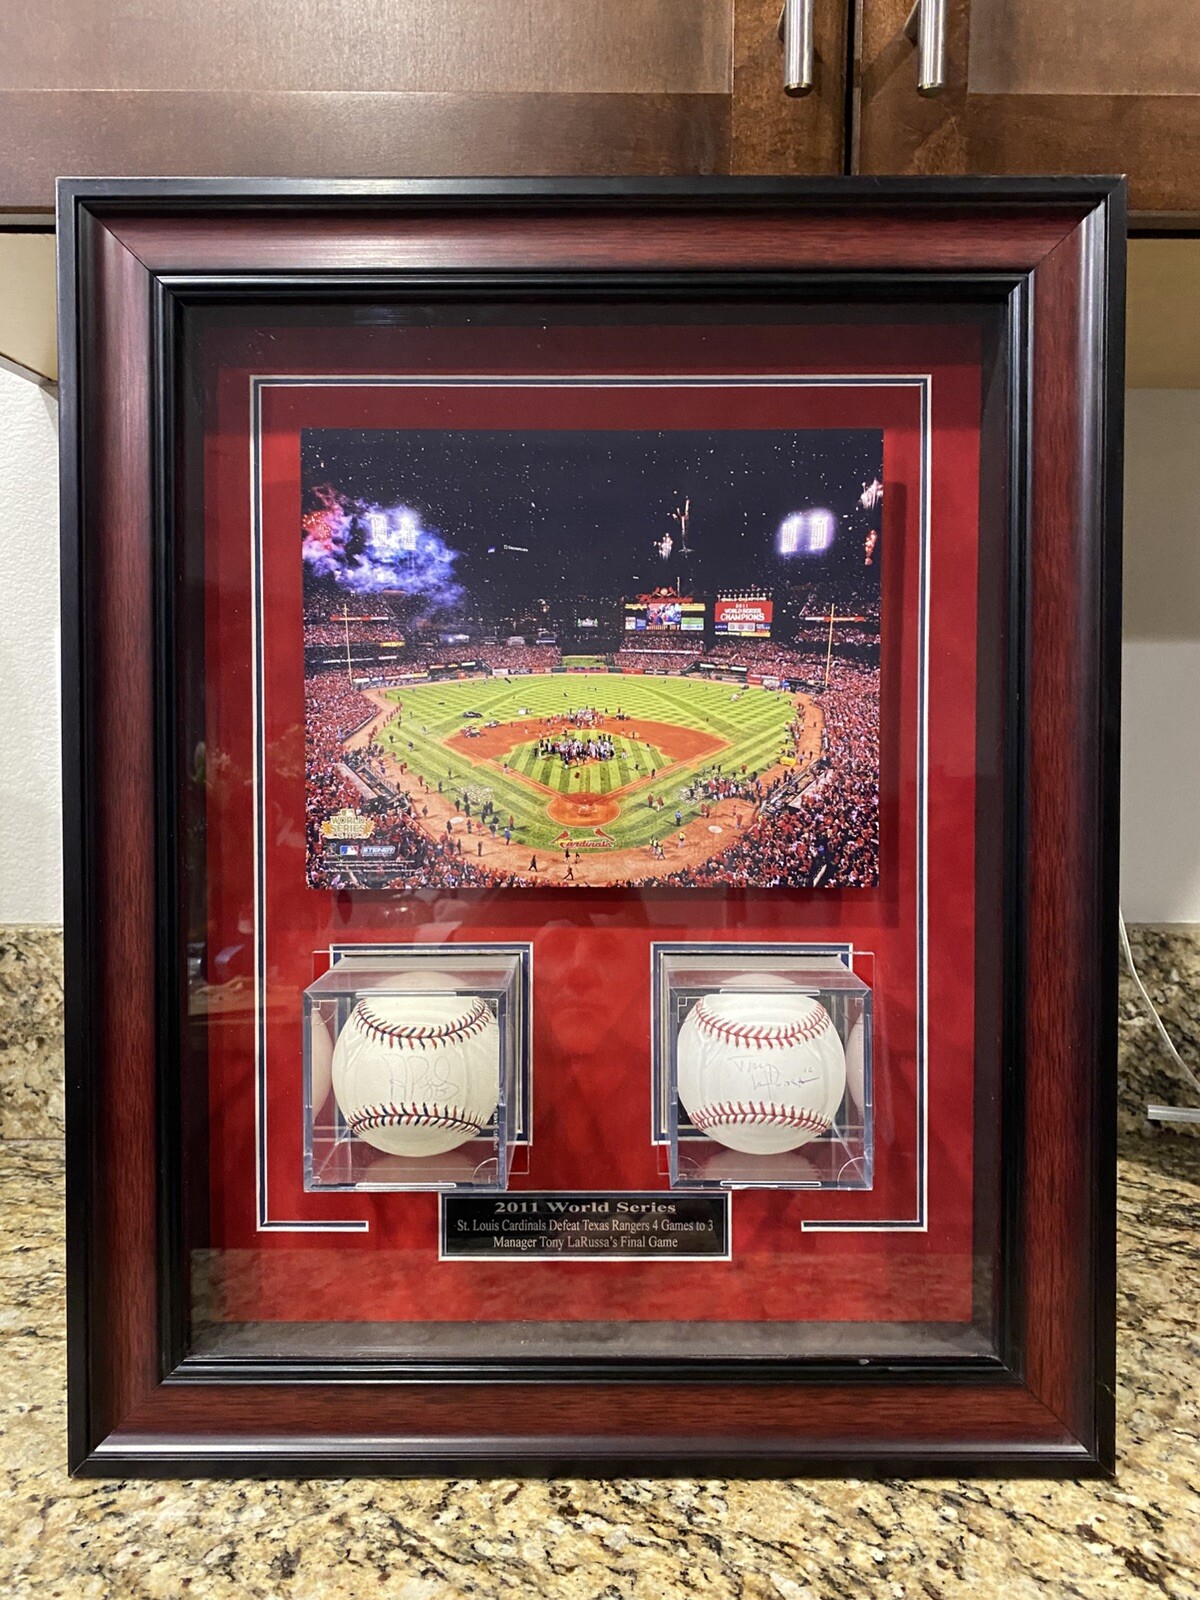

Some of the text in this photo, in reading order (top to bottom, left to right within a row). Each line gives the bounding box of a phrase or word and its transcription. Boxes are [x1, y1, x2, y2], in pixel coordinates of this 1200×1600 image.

[719, 612, 765, 621] CHAMPIONS
[331, 816, 365, 824] WORLD
[331, 824, 365, 832] SERIES
[494, 1201, 677, 1213] 2011 World Series
[457, 1219, 714, 1234] St. Louis Cardinals Defeat Texas Rangers 4 Games to 3
[493, 1235, 679, 1251] Manager Tony LaRussa's Final Game
